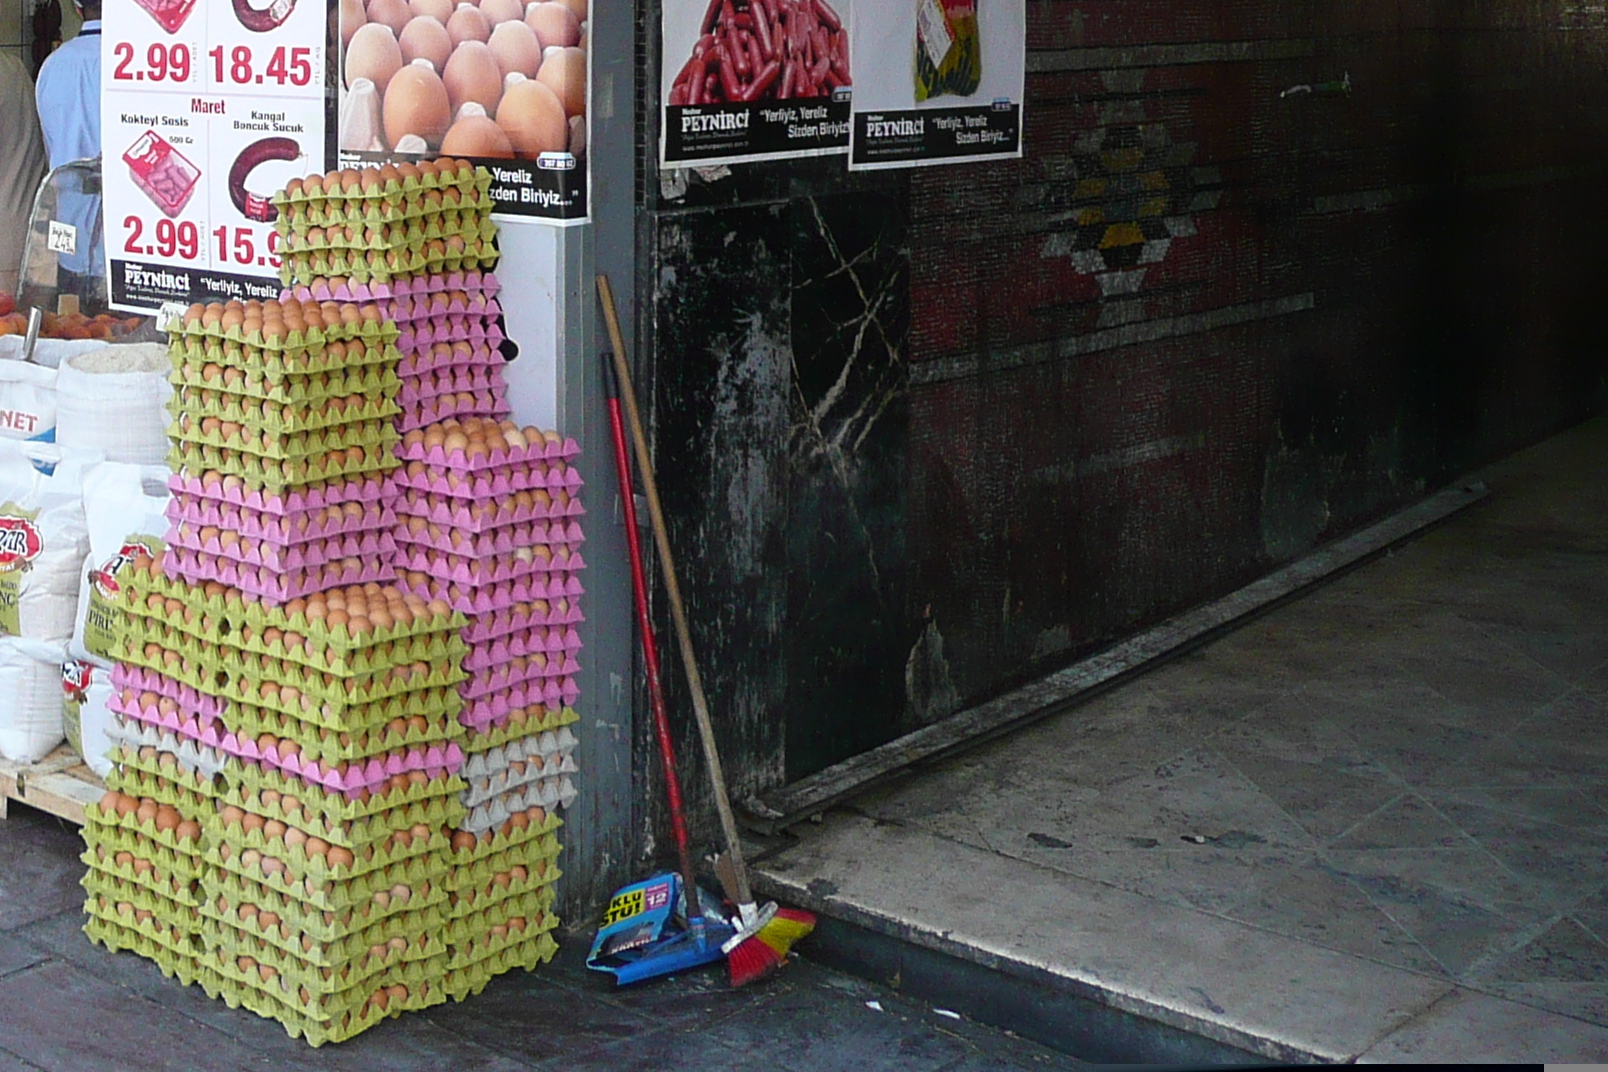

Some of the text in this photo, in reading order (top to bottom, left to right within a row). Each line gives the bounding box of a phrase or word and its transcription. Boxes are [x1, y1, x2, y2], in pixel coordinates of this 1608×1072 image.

[113, 41, 191, 83] 2.99
[208, 44, 312, 86] 18.45
[191, 98, 226, 116] Maret
[799, 105, 829, 120] Yereliz
[120, 113, 190, 128] Kokteyl Sosis
[251, 110, 286, 123] Kangal
[680, 109, 751, 133] PEYNİRCİ
[233, 121, 304, 134] Boncuk Sucuk
[787, 123, 819, 139] Sizden
[866, 116, 925, 138] PEYNİRCİ
[955, 131, 980, 146] Sizden
[492, 167, 533, 186] Yereliz
[123, 215, 199, 260] 2.99
[124, 269, 191, 291] PEYNİRCİ
[244, 282, 278, 298] Yereliz
